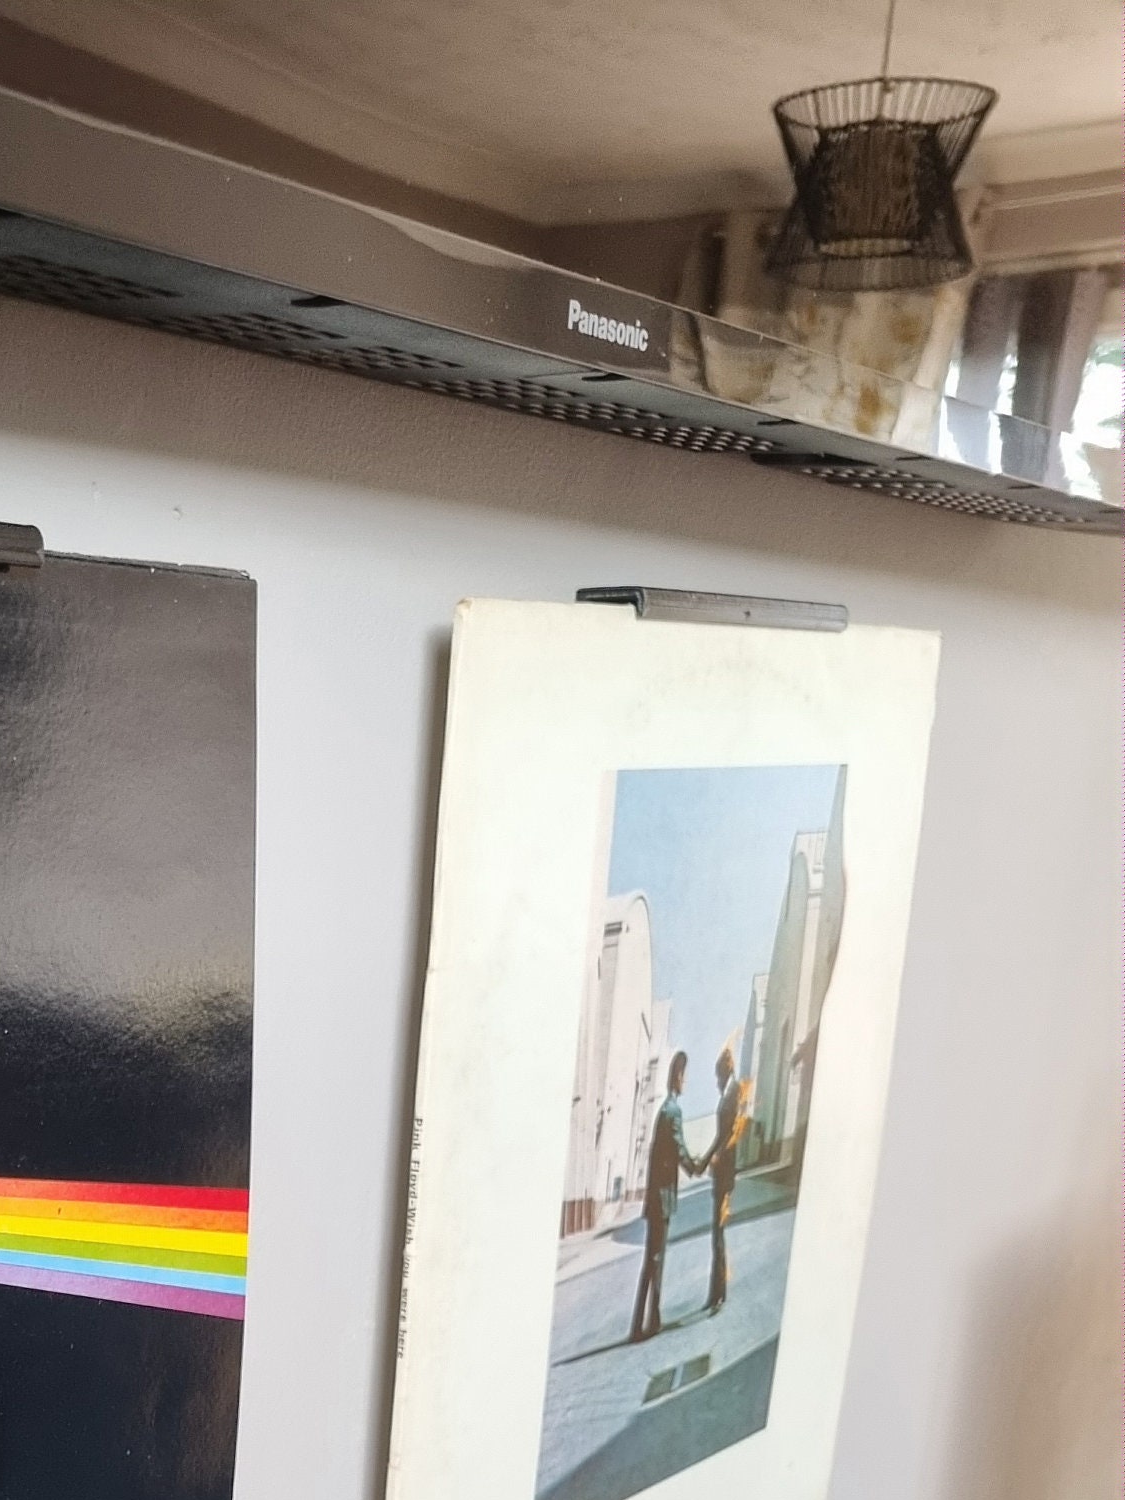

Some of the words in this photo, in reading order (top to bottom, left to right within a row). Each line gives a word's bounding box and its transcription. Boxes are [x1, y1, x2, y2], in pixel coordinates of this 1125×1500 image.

[567, 299, 649, 352] Panasonic
[411, 1117, 423, 1150] Pink
[399, 1287, 409, 1324] were
[396, 1327, 408, 1360] here
